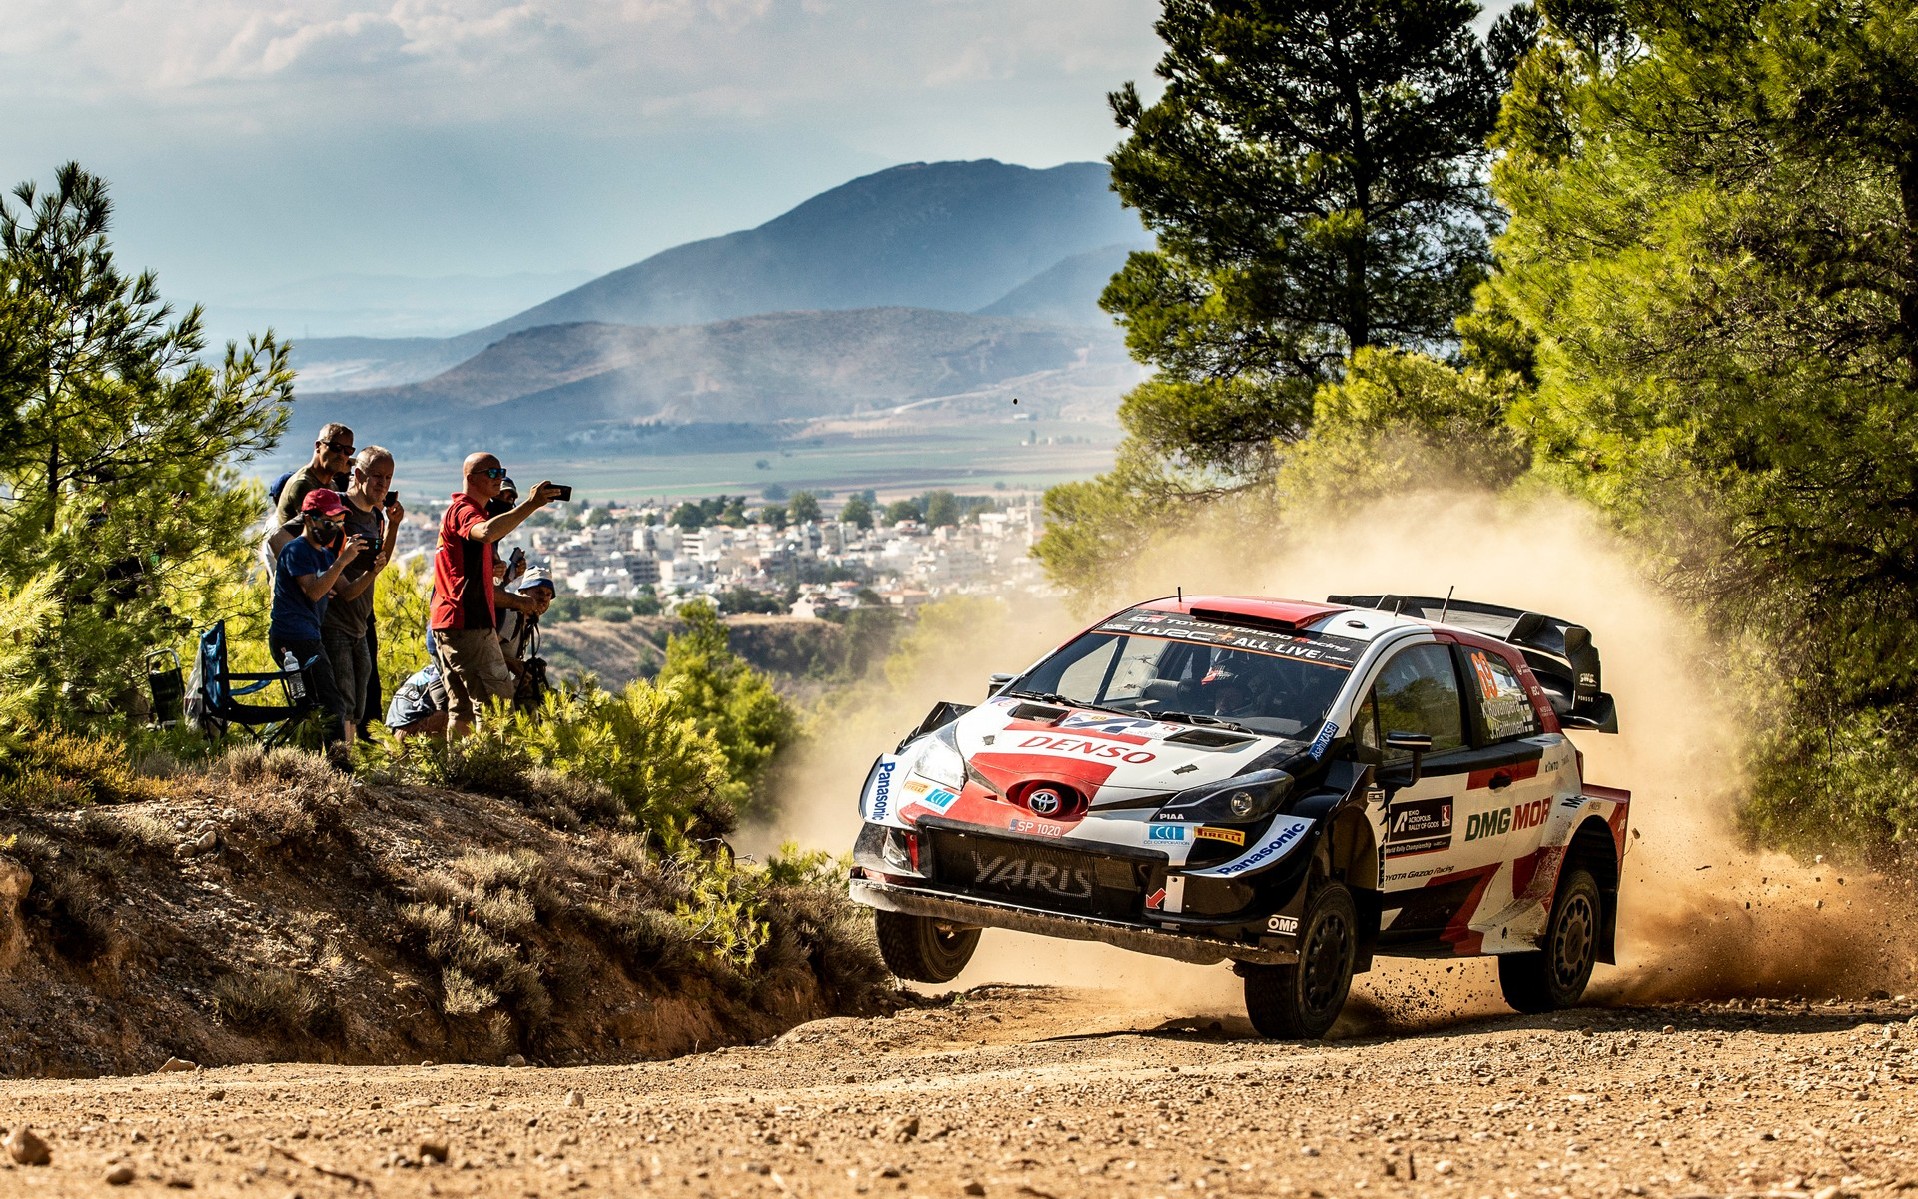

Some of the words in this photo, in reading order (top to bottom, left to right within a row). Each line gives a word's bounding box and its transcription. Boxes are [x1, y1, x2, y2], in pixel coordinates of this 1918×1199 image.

[1166, 618, 1230, 630] TOYOTA
[1232, 626, 1293, 640] GAZOO
[1294, 637, 1351, 652] Racing
[1232, 637, 1271, 650] ALL
[1275, 643, 1322, 659] LIVE
[1471, 651, 1498, 700] 69
[1018, 736, 1156, 764] DENSO
[872, 762, 896, 821] Panasonic
[1017, 821, 1034, 832] SP
[1037, 824, 1061, 836] 1020
[1408, 815, 1432, 823] ACROPOLIS
[1427, 821, 1440, 829] GODS
[1464, 807, 1511, 842] DMG
[1155, 826, 1176, 839] CCI
[1197, 828, 1241, 842] PIRELLI
[1216, 823, 1305, 875] Panasonic
[970, 851, 1092, 898] YARIS
[1407, 869, 1433, 879] GAZOO
[1433, 865, 1454, 875] Racing
[1268, 917, 1298, 932] OMP
